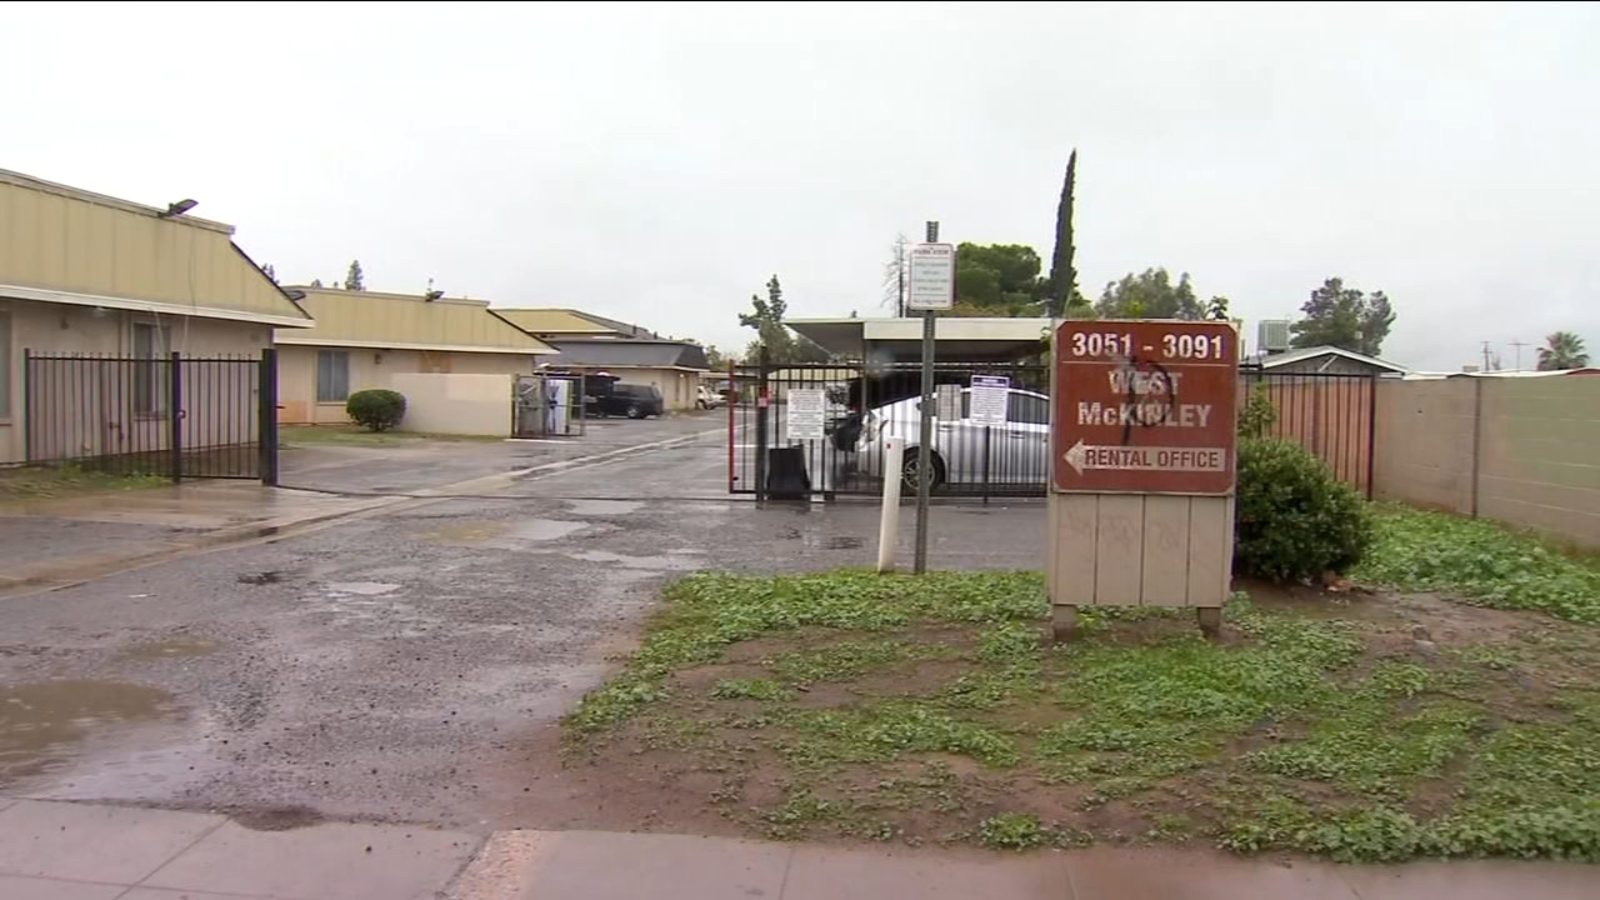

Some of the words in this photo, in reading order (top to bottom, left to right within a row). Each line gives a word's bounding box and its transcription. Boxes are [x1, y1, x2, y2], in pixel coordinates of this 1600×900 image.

[1072, 332, 1132, 357] 3051
[1162, 334, 1222, 359] 3091
[1108, 370, 1182, 395] WEST
[1078, 402, 1212, 427] McKINLEY
[1085, 449, 1152, 468] RENTAL
[1157, 451, 1219, 468] OFFICE
